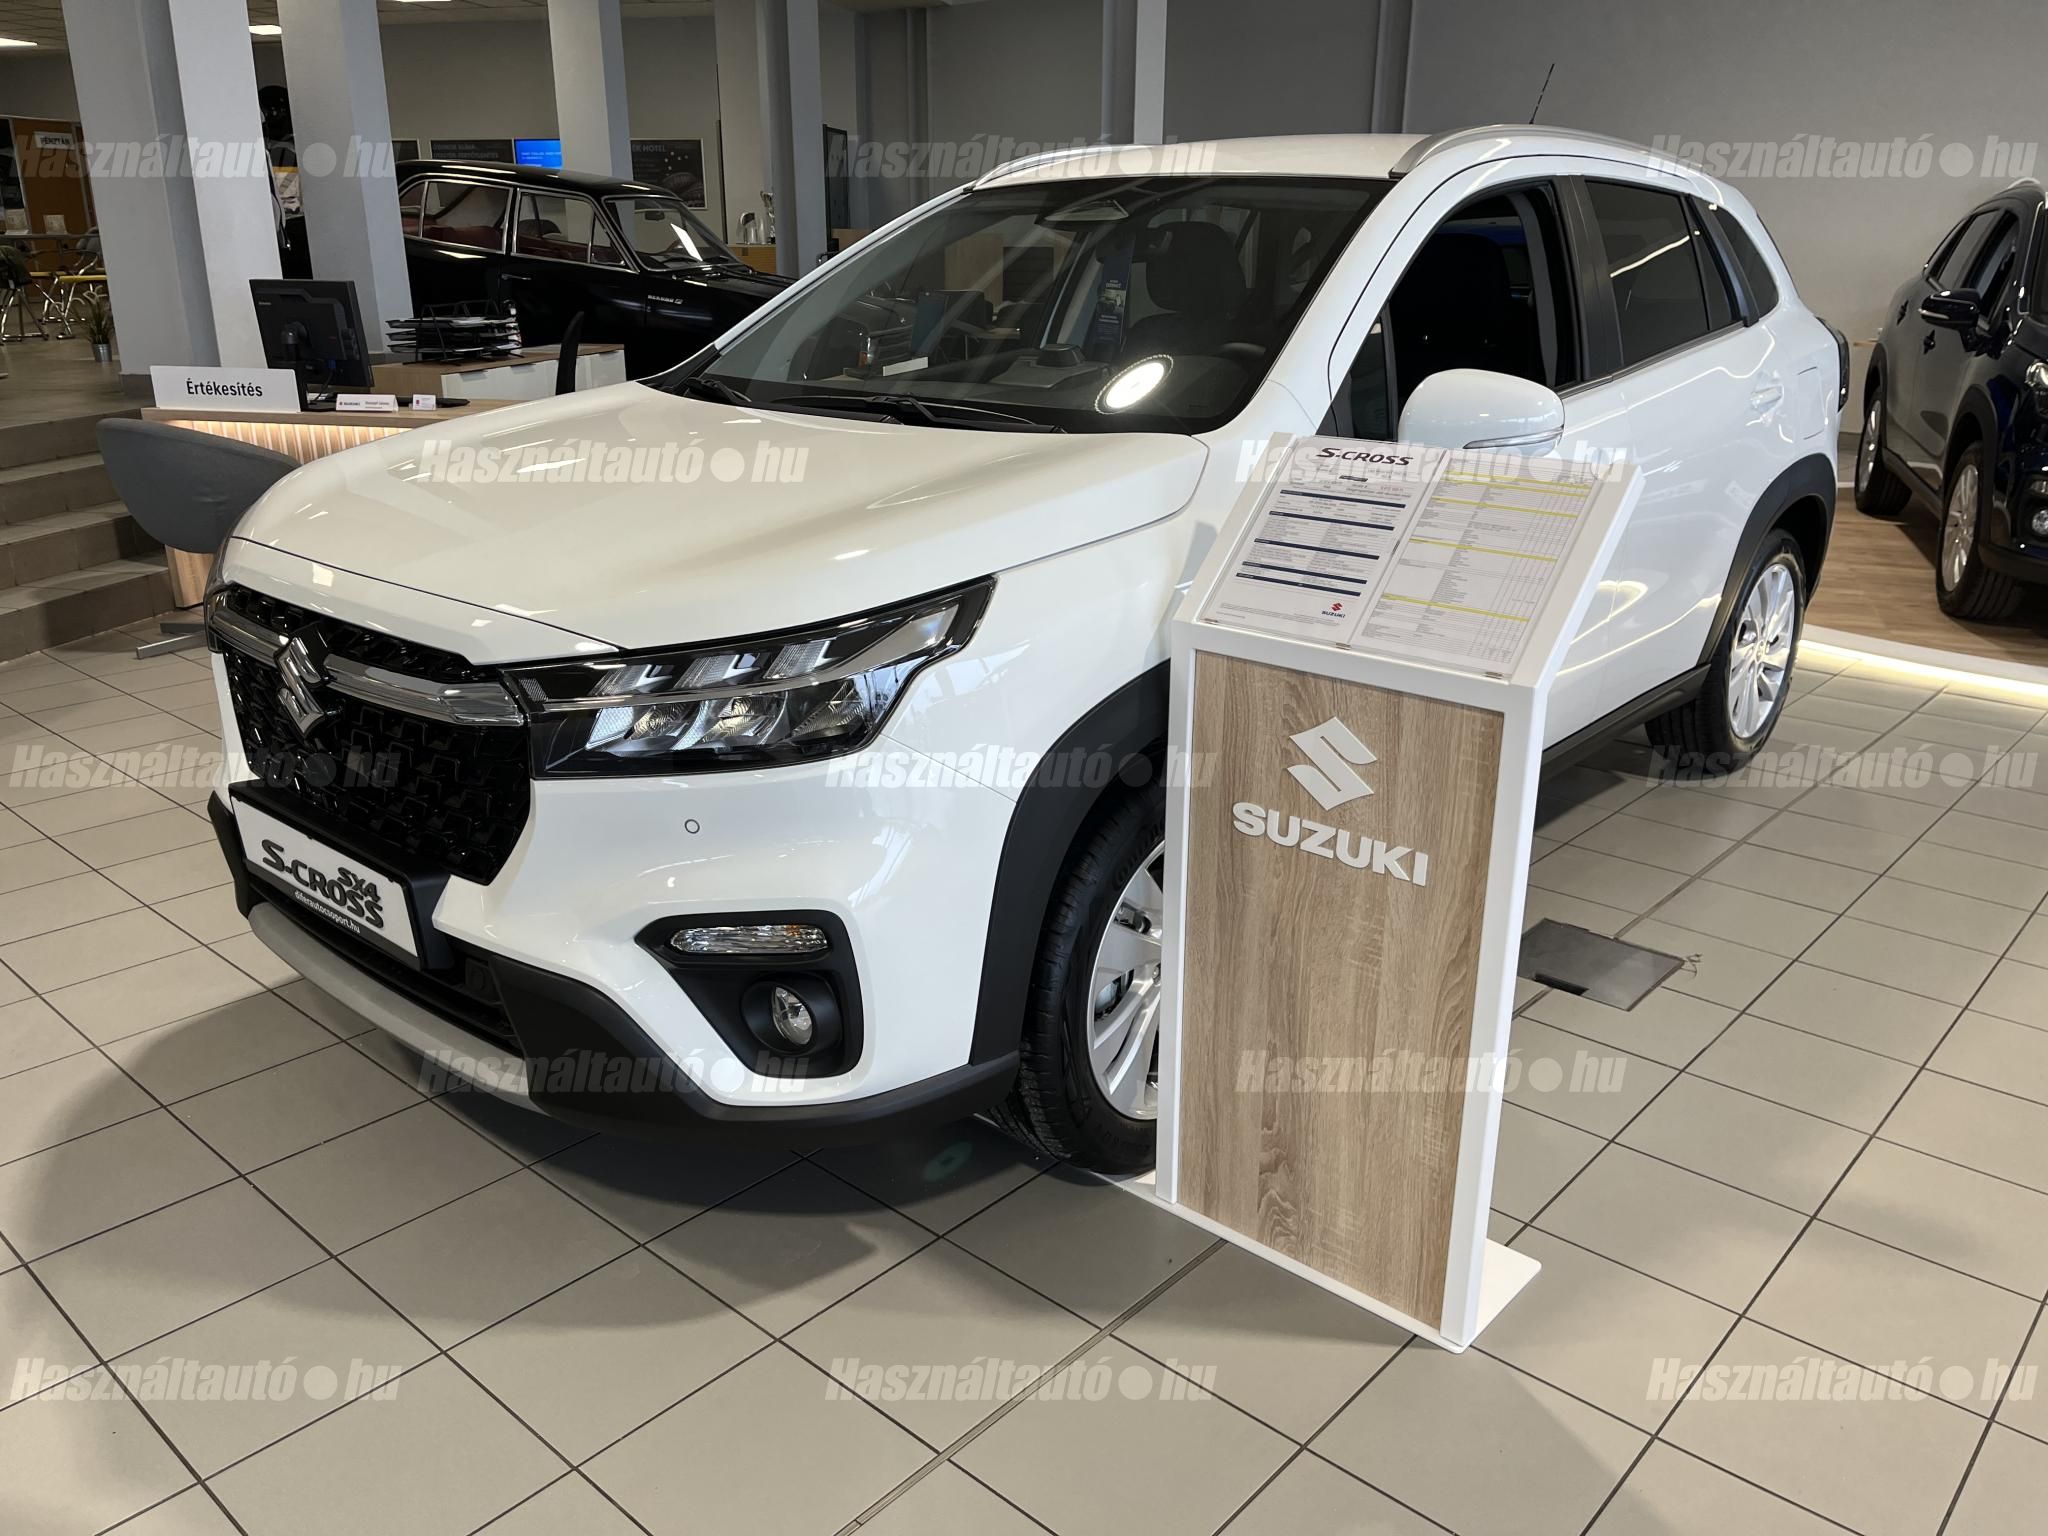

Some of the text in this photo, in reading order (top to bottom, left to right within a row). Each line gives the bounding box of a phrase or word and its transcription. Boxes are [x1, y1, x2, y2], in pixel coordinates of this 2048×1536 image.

[186, 378, 263, 397] Értékesítés
[1321, 610, 1346, 618] SUZUKI
[1232, 802, 1429, 887] SUZUKI
[337, 867, 381, 903] SX4
